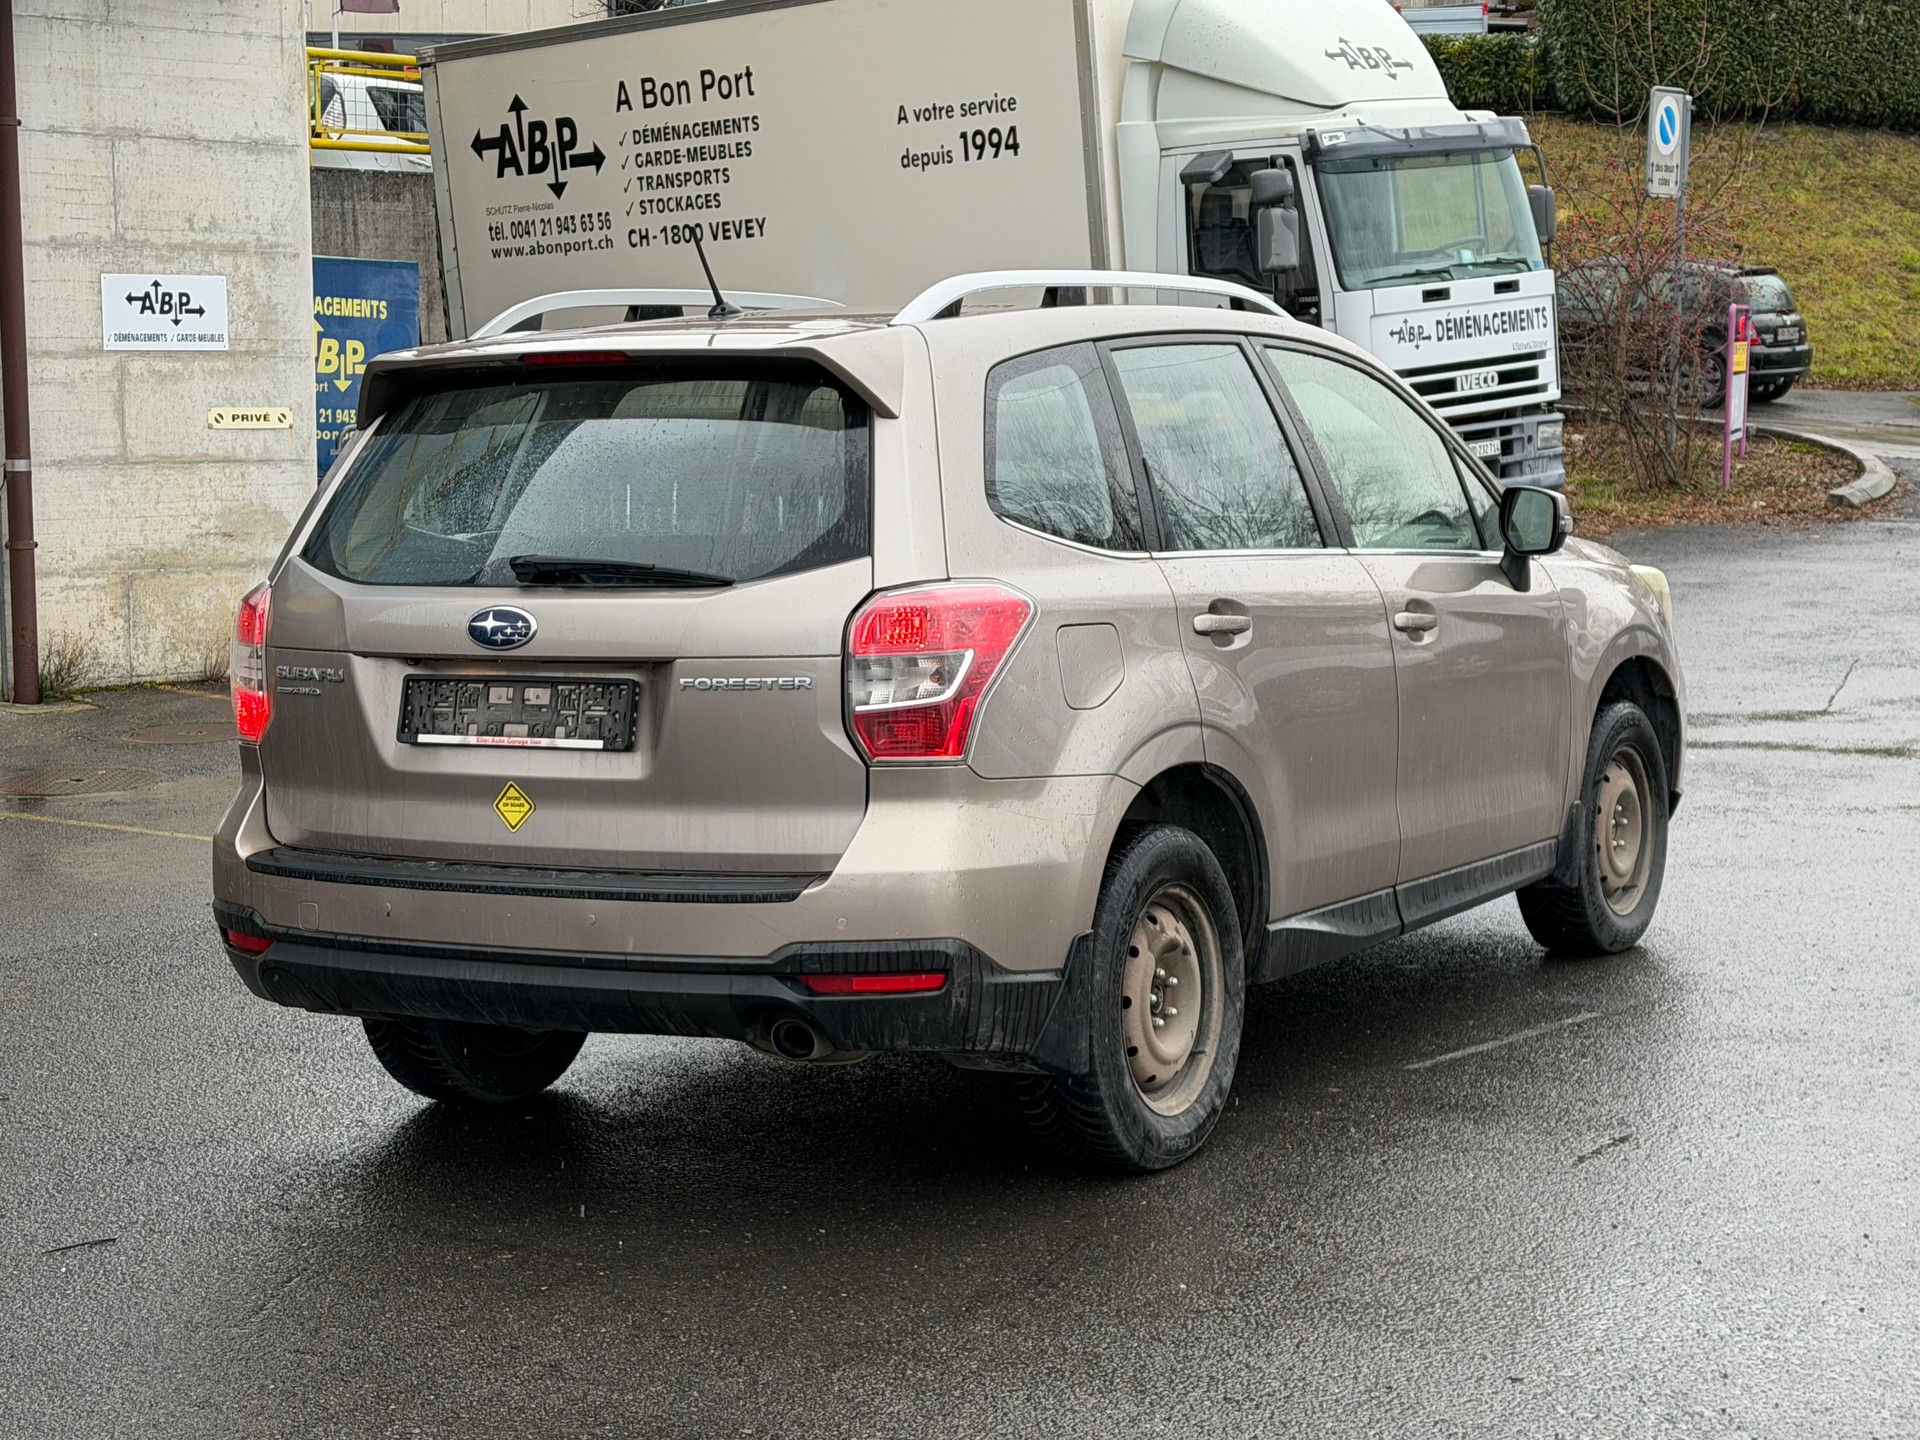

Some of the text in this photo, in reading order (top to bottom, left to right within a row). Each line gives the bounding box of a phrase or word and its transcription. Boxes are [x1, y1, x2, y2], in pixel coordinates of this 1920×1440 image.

[616, 65, 755, 113] A Bon Port
[897, 92, 1017, 125] A votre service
[632, 115, 760, 145] DÉMÉNAGEMENTS
[497, 116, 578, 179] ABP
[634, 140, 752, 169] GARDE-MEUBLES
[900, 125, 1020, 172] depuis 1994
[637, 167, 731, 192] TRANSPORTS
[639, 192, 722, 216] STOCKAGES
[488, 211, 612, 241] tél. 0041 21 943 63 56
[708, 217, 766, 241] VEVEY
[491, 234, 614, 259] www.abonport.ch
[139, 291, 191, 315] ABP
[113, 330, 225, 343] DÉMÉNAGEMENTS GARDE-MEUBLES
[1435, 306, 1548, 343] DÉMÉNAGEMENTS
[1456, 371, 1499, 392] IVECO
[231, 411, 271, 423] PRIVÉ
[319, 408, 357, 424] 21 943
[276, 665, 344, 682] SUBARU
[679, 677, 813, 691] FORESTER
